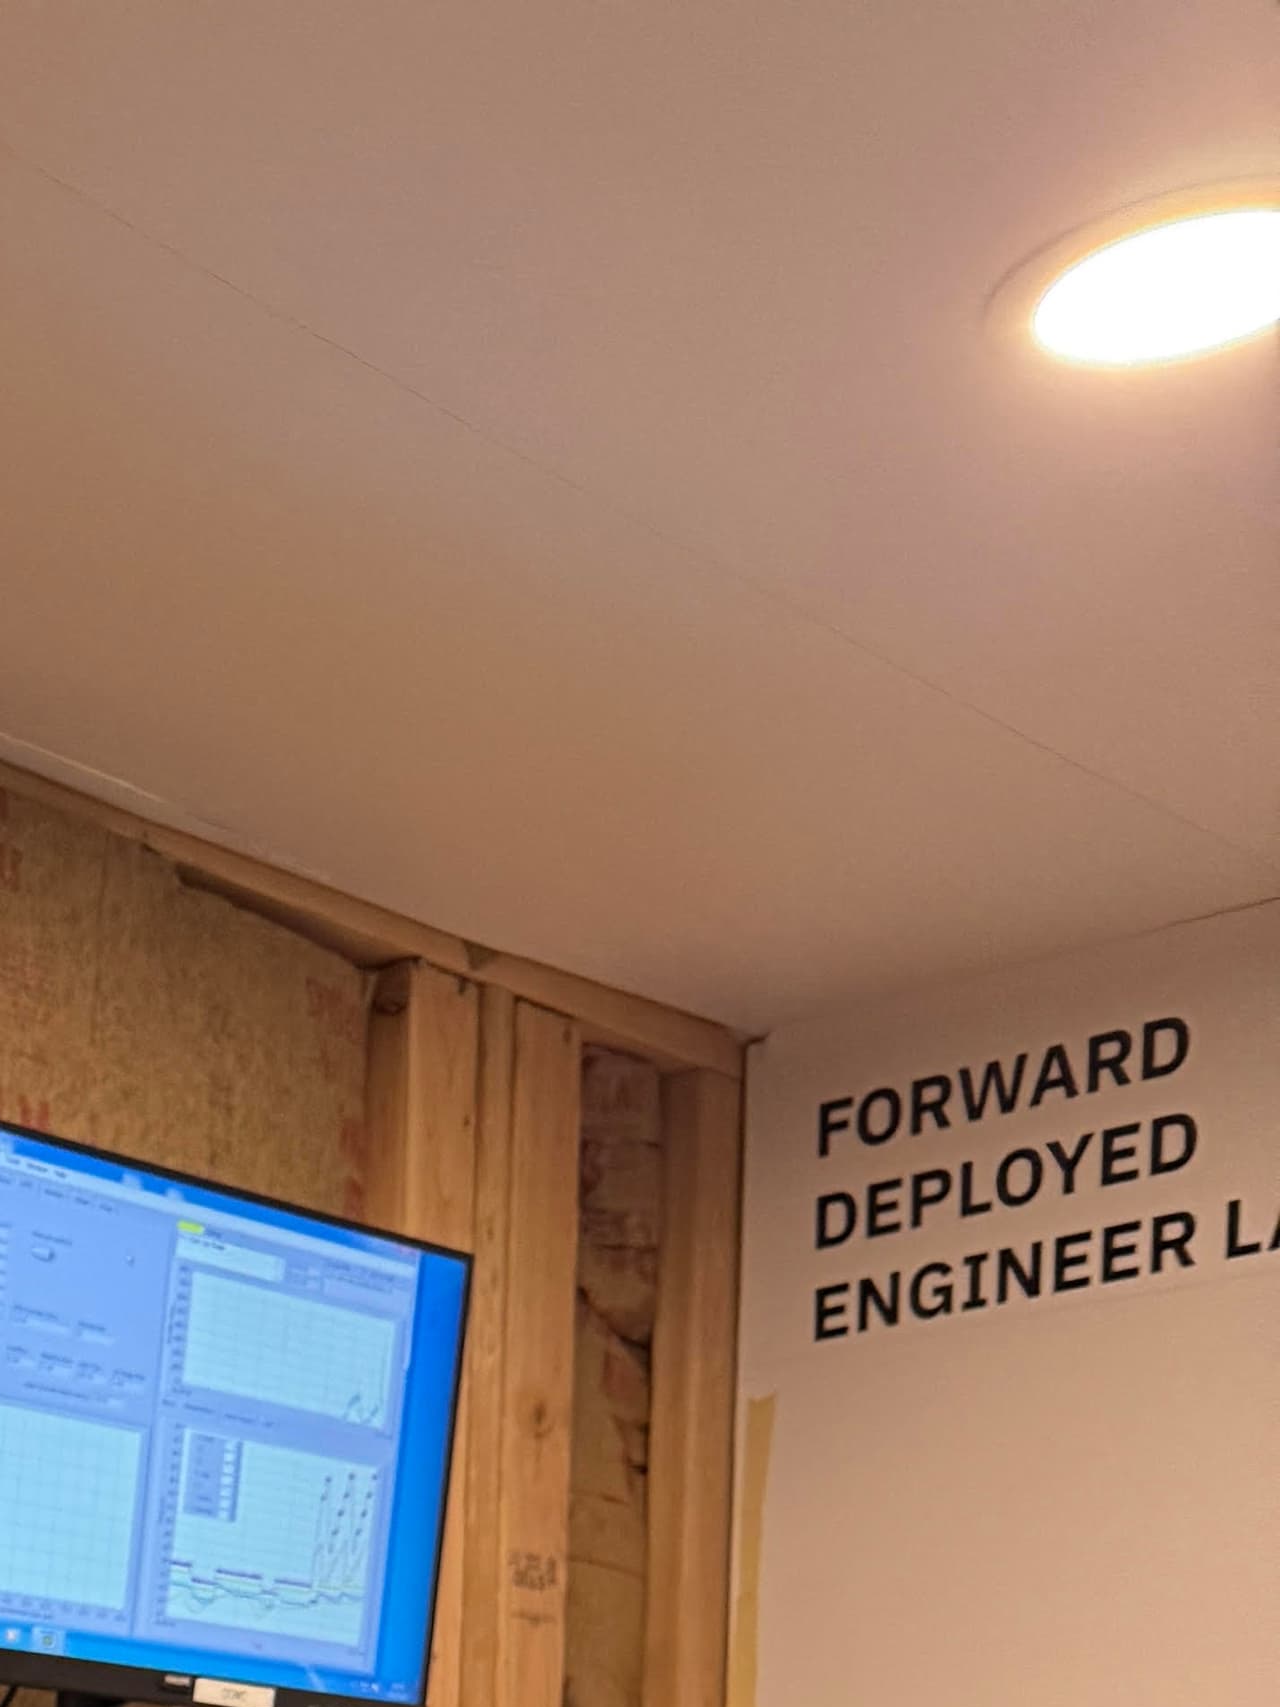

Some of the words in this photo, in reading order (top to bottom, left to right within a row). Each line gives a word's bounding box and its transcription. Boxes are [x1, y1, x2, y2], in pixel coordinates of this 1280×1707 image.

[818, 1016, 1190, 1158] FORWARD
[815, 1113, 1198, 1250] DEPLOYED
[814, 1211, 1197, 1342] ENGINEER
[1226, 1199, 1280, 1260] L
